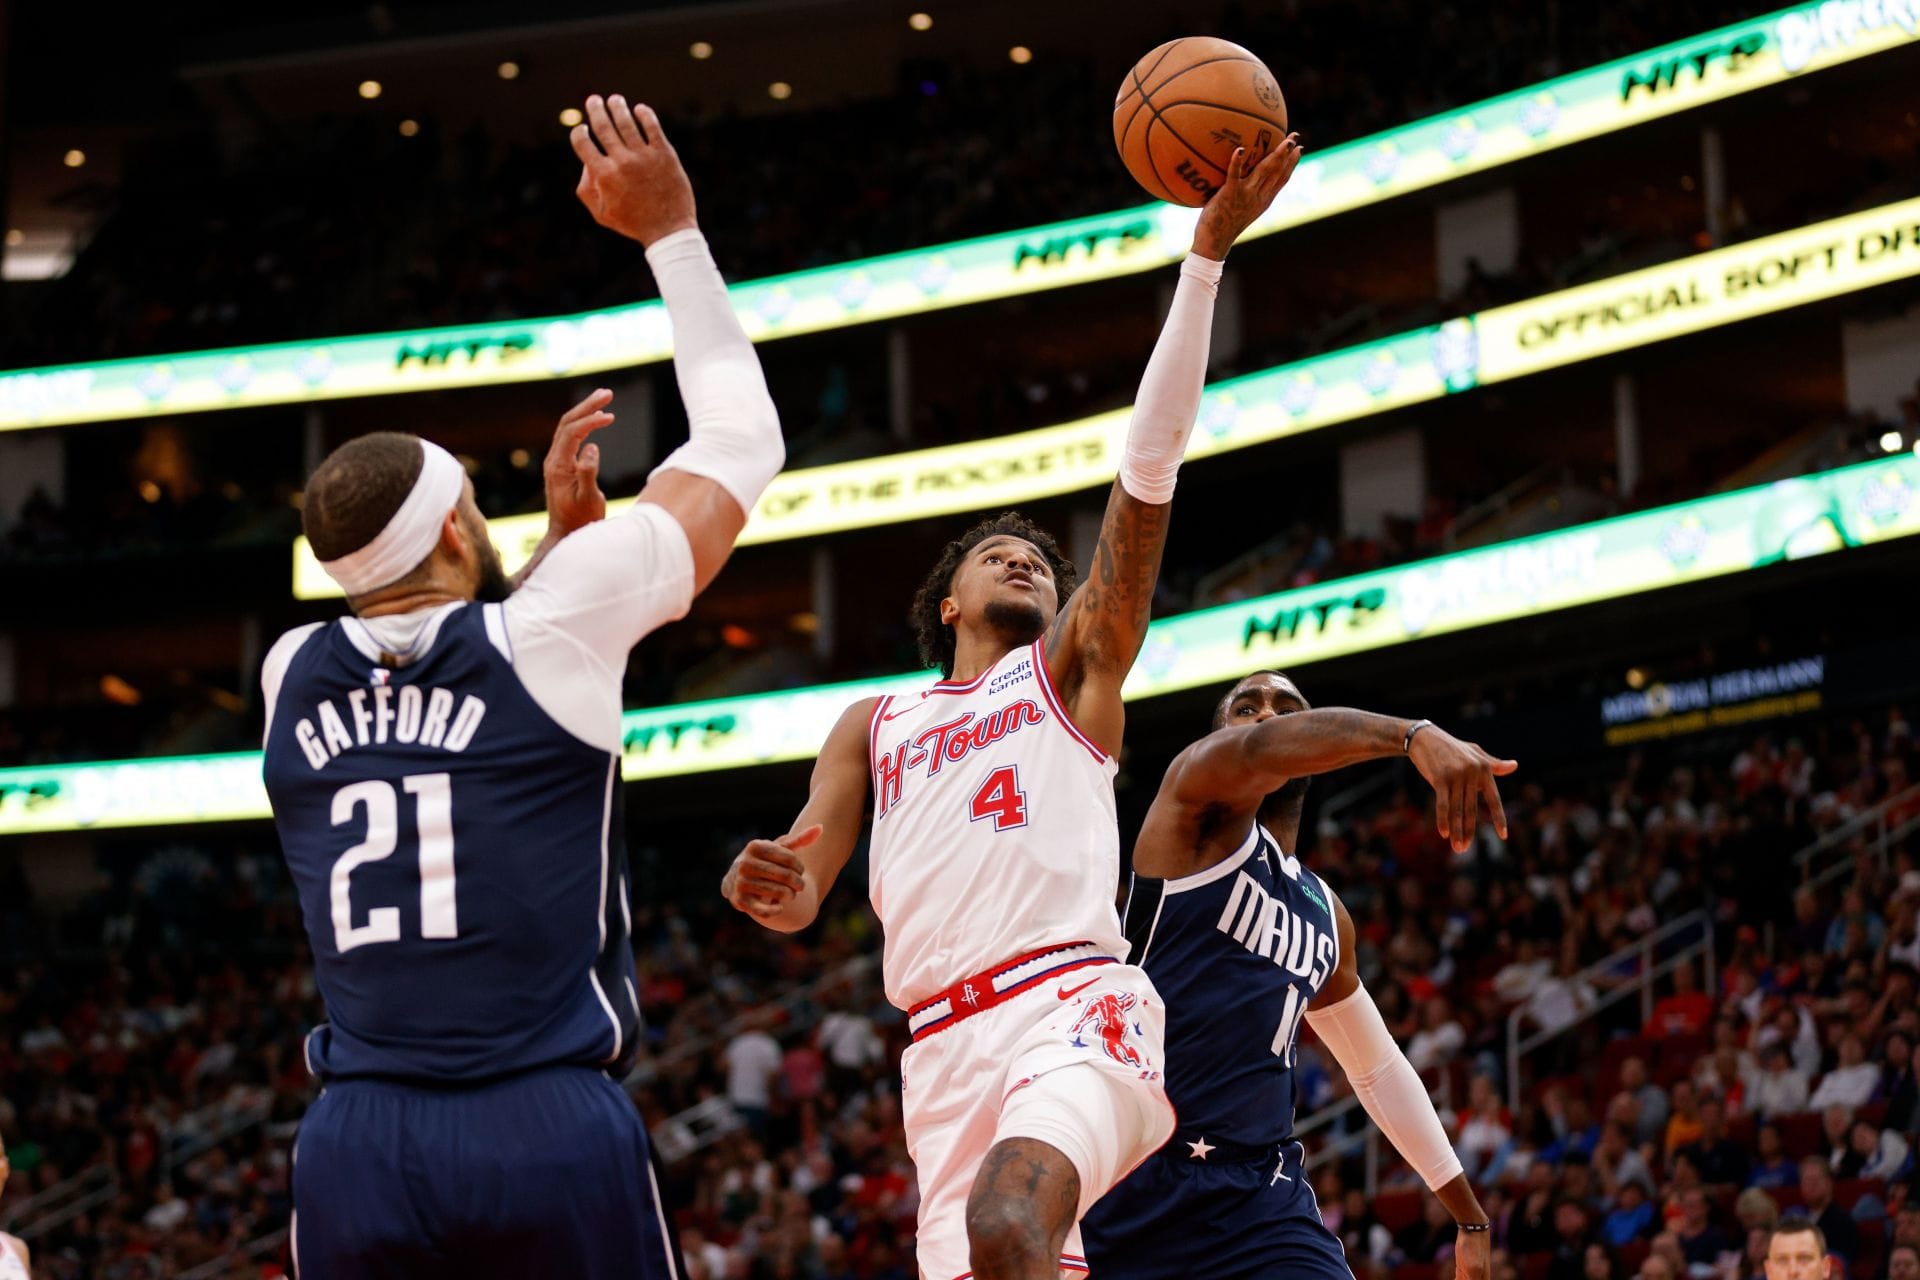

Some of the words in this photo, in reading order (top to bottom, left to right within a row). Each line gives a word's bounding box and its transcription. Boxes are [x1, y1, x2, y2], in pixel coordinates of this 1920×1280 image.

[1518, 282, 1707, 349] OFFICIAL
[1724, 246, 1844, 296] SOFT
[829, 478, 900, 505] THE
[914, 440, 1105, 492] ROCKETS
[988, 671, 1033, 696] karma
[990, 659, 1032, 686] credit
[295, 684, 487, 770] GAFFORD
[877, 699, 1046, 820] H-Town
[969, 764, 1028, 832] 4
[330, 772, 458, 954] 21
